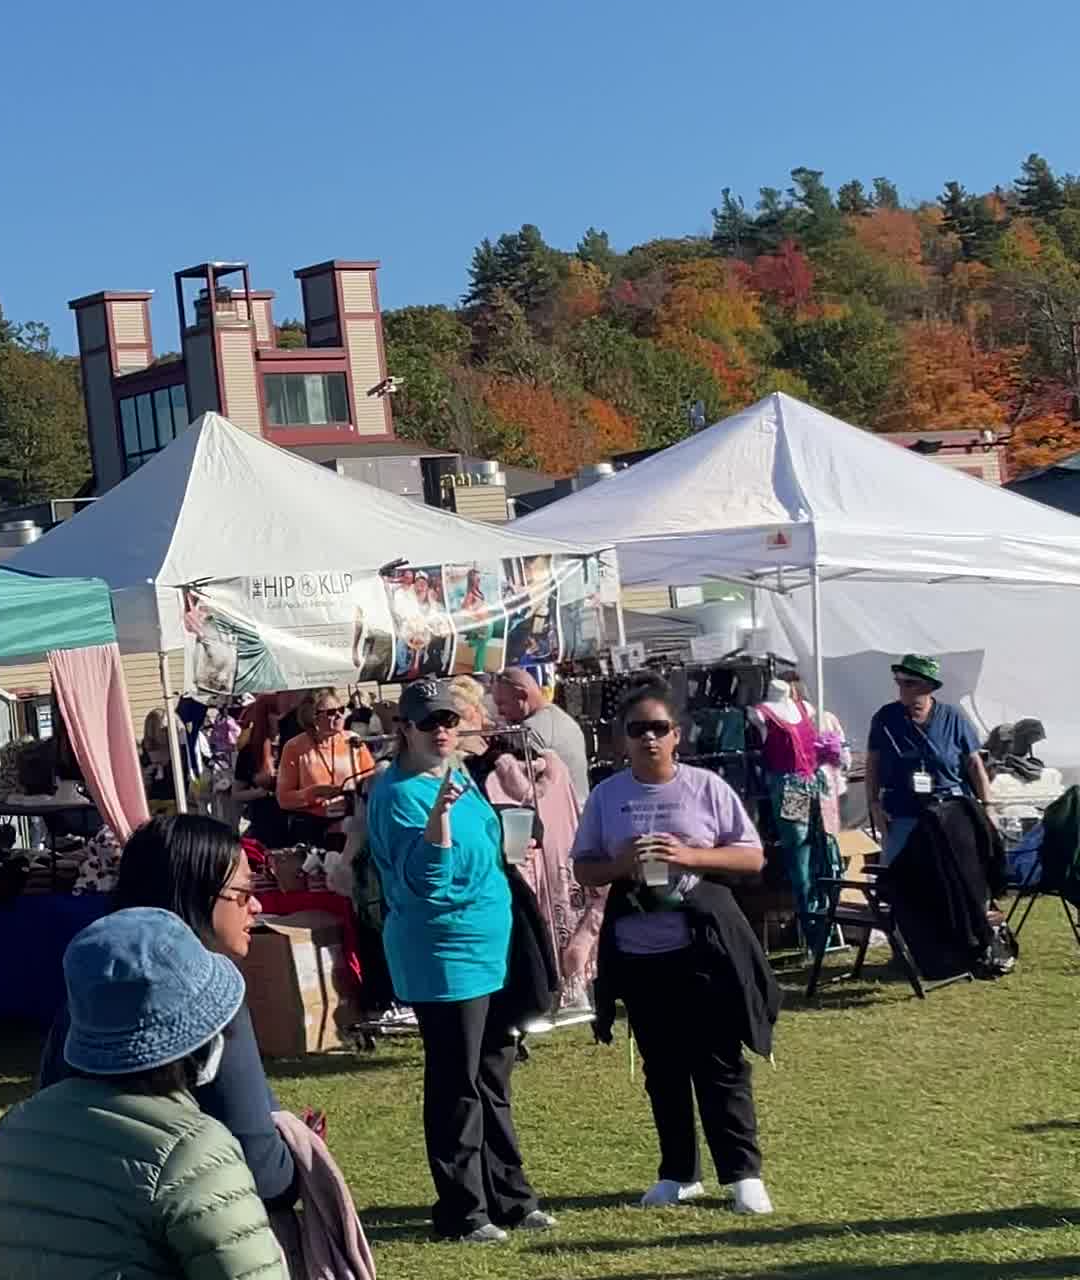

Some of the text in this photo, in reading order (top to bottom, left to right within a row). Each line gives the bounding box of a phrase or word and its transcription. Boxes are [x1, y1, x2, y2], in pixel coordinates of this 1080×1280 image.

[253, 577, 263, 600] THE
[264, 575, 295, 598] HIP
[320, 573, 353, 595] KLIP
